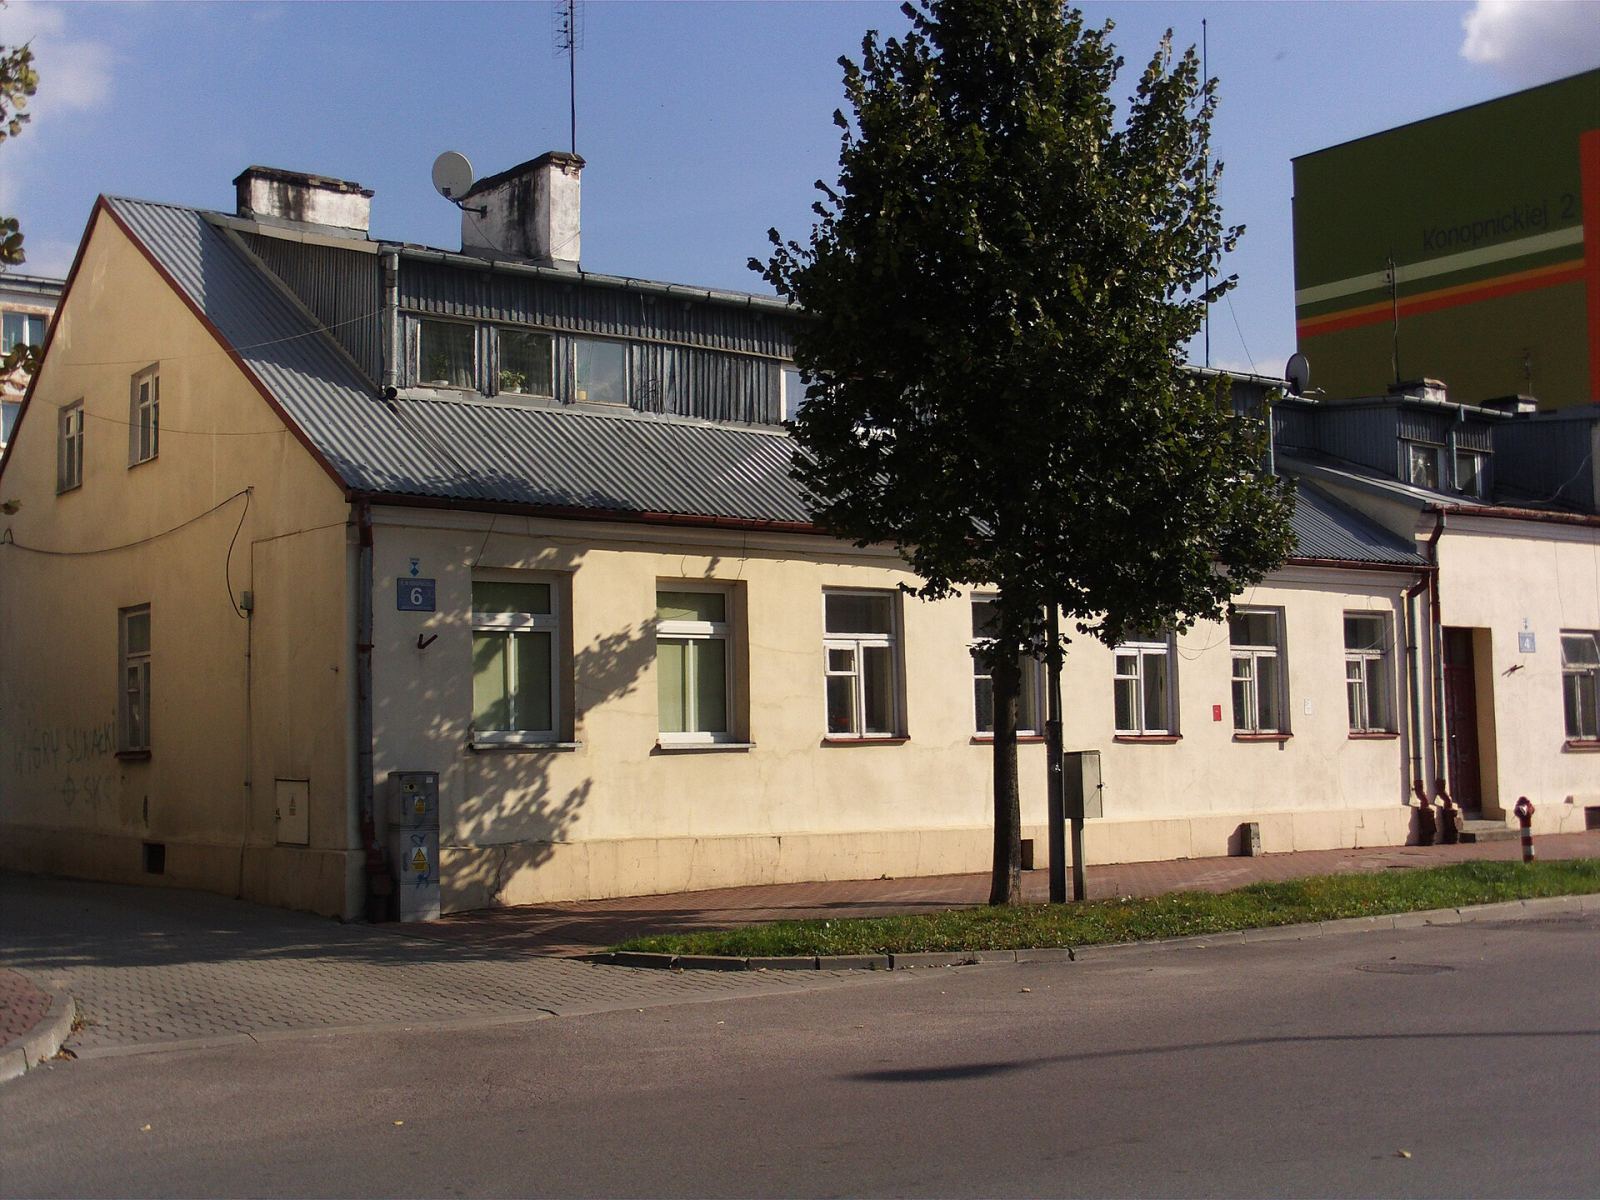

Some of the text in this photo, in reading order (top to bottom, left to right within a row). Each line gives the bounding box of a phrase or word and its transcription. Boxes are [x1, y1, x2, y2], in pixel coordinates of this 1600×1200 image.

[1423, 193, 1575, 251] Konopnickiej 2
[410, 587, 423, 605] 6
